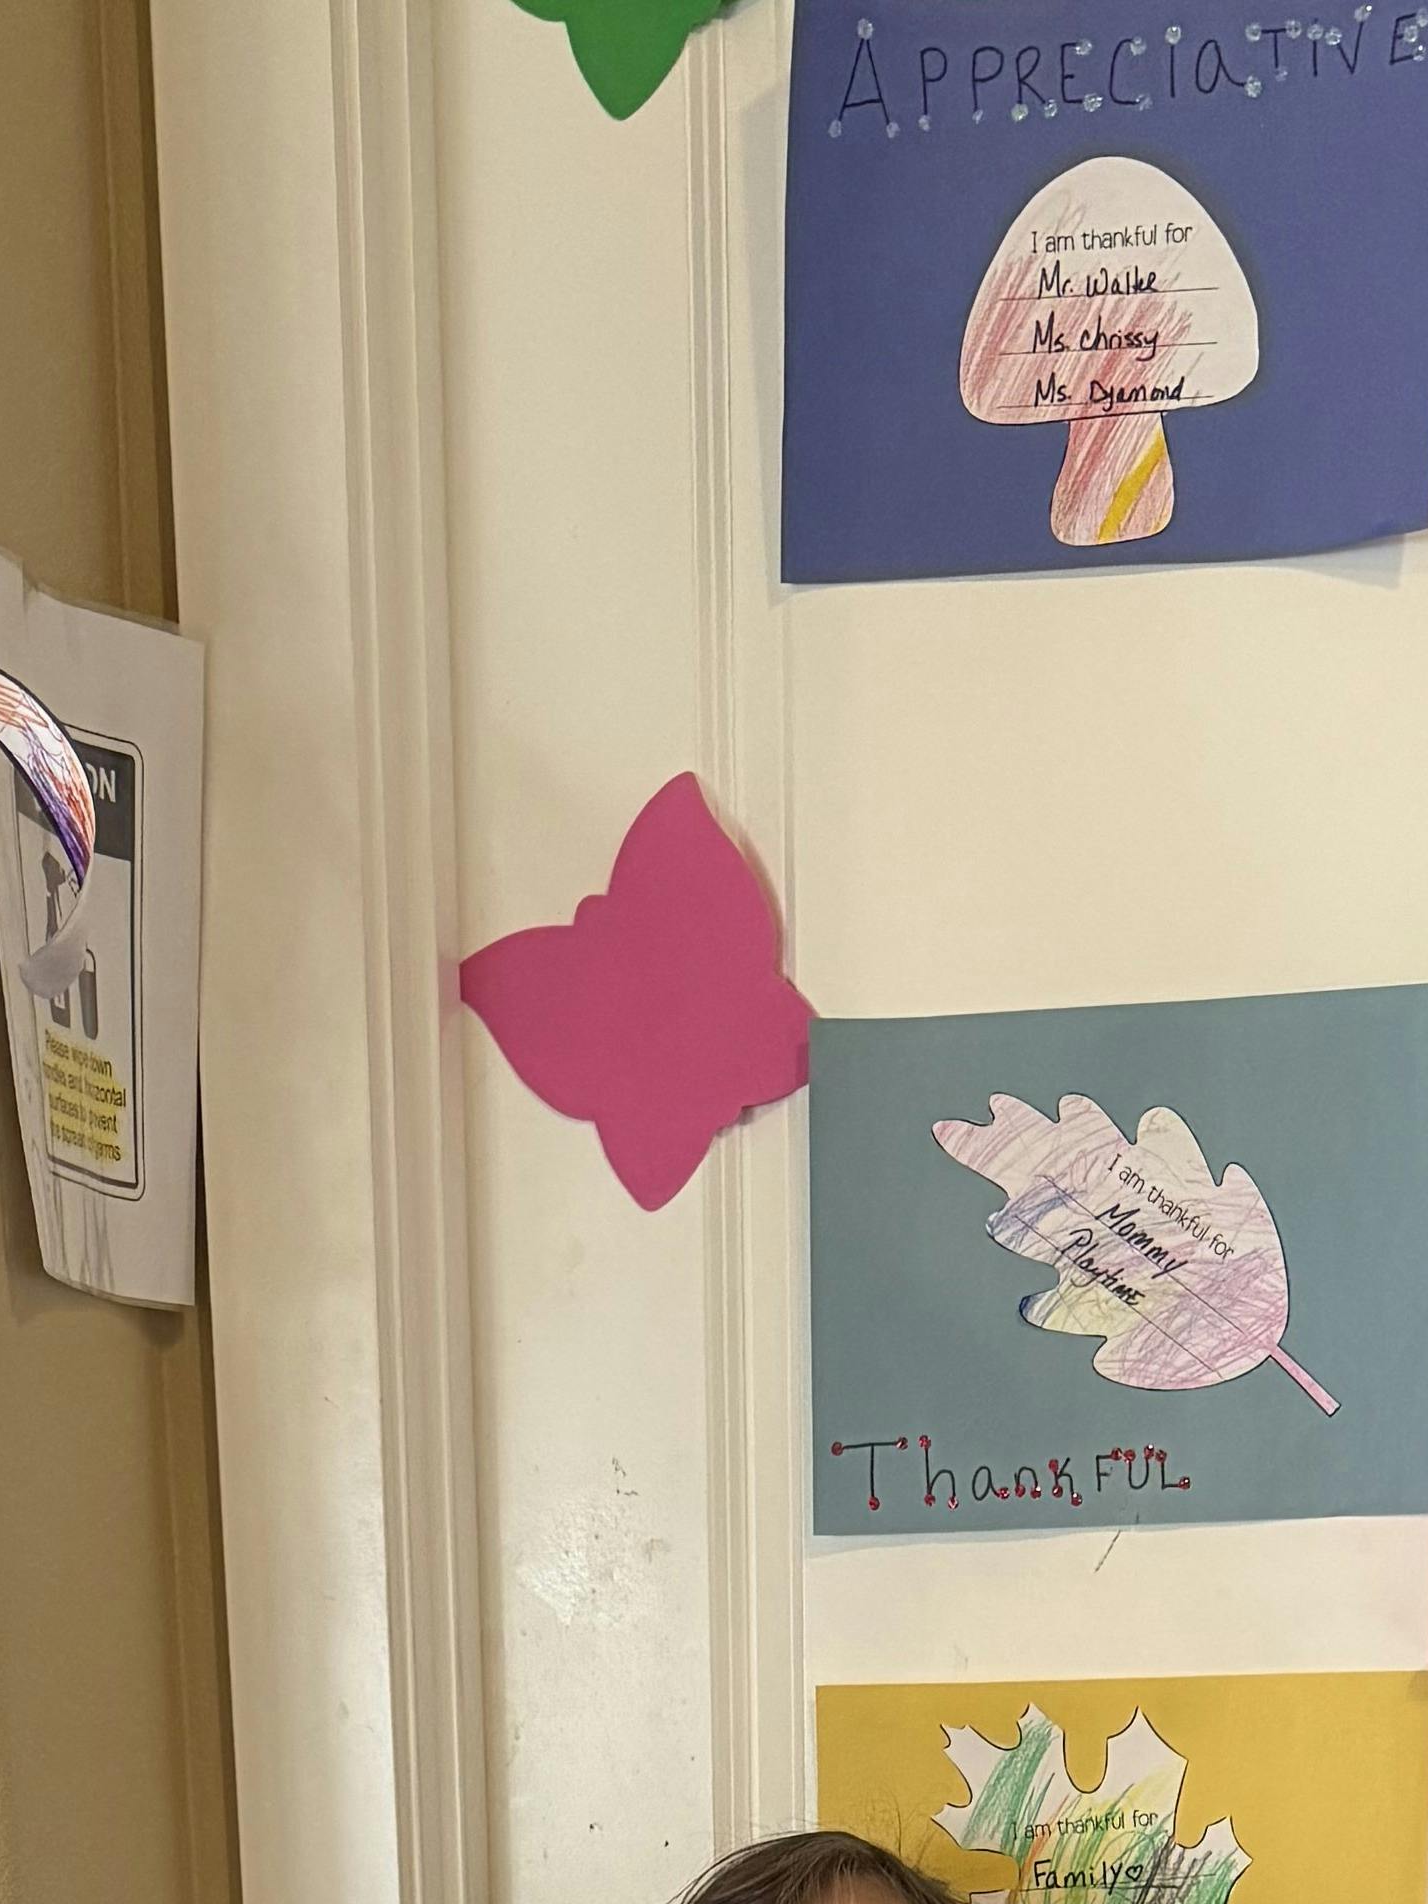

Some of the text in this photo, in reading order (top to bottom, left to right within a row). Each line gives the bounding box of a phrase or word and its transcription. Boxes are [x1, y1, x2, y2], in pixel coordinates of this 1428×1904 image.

[1031, 222, 1194, 254] I am thankful for
[1038, 260, 1074, 299] Mr.
[1032, 312, 1071, 354] Ms.
[1034, 372, 1073, 408] Ms.
[1107, 1153, 1234, 1260] I am thankful for
[1095, 1203, 1189, 1280] Mommy
[1024, 1823, 1051, 1839] am
[1057, 1812, 1125, 1837] thankful
[1132, 1809, 1159, 1828] for
[1033, 1859, 1123, 1896] Family
